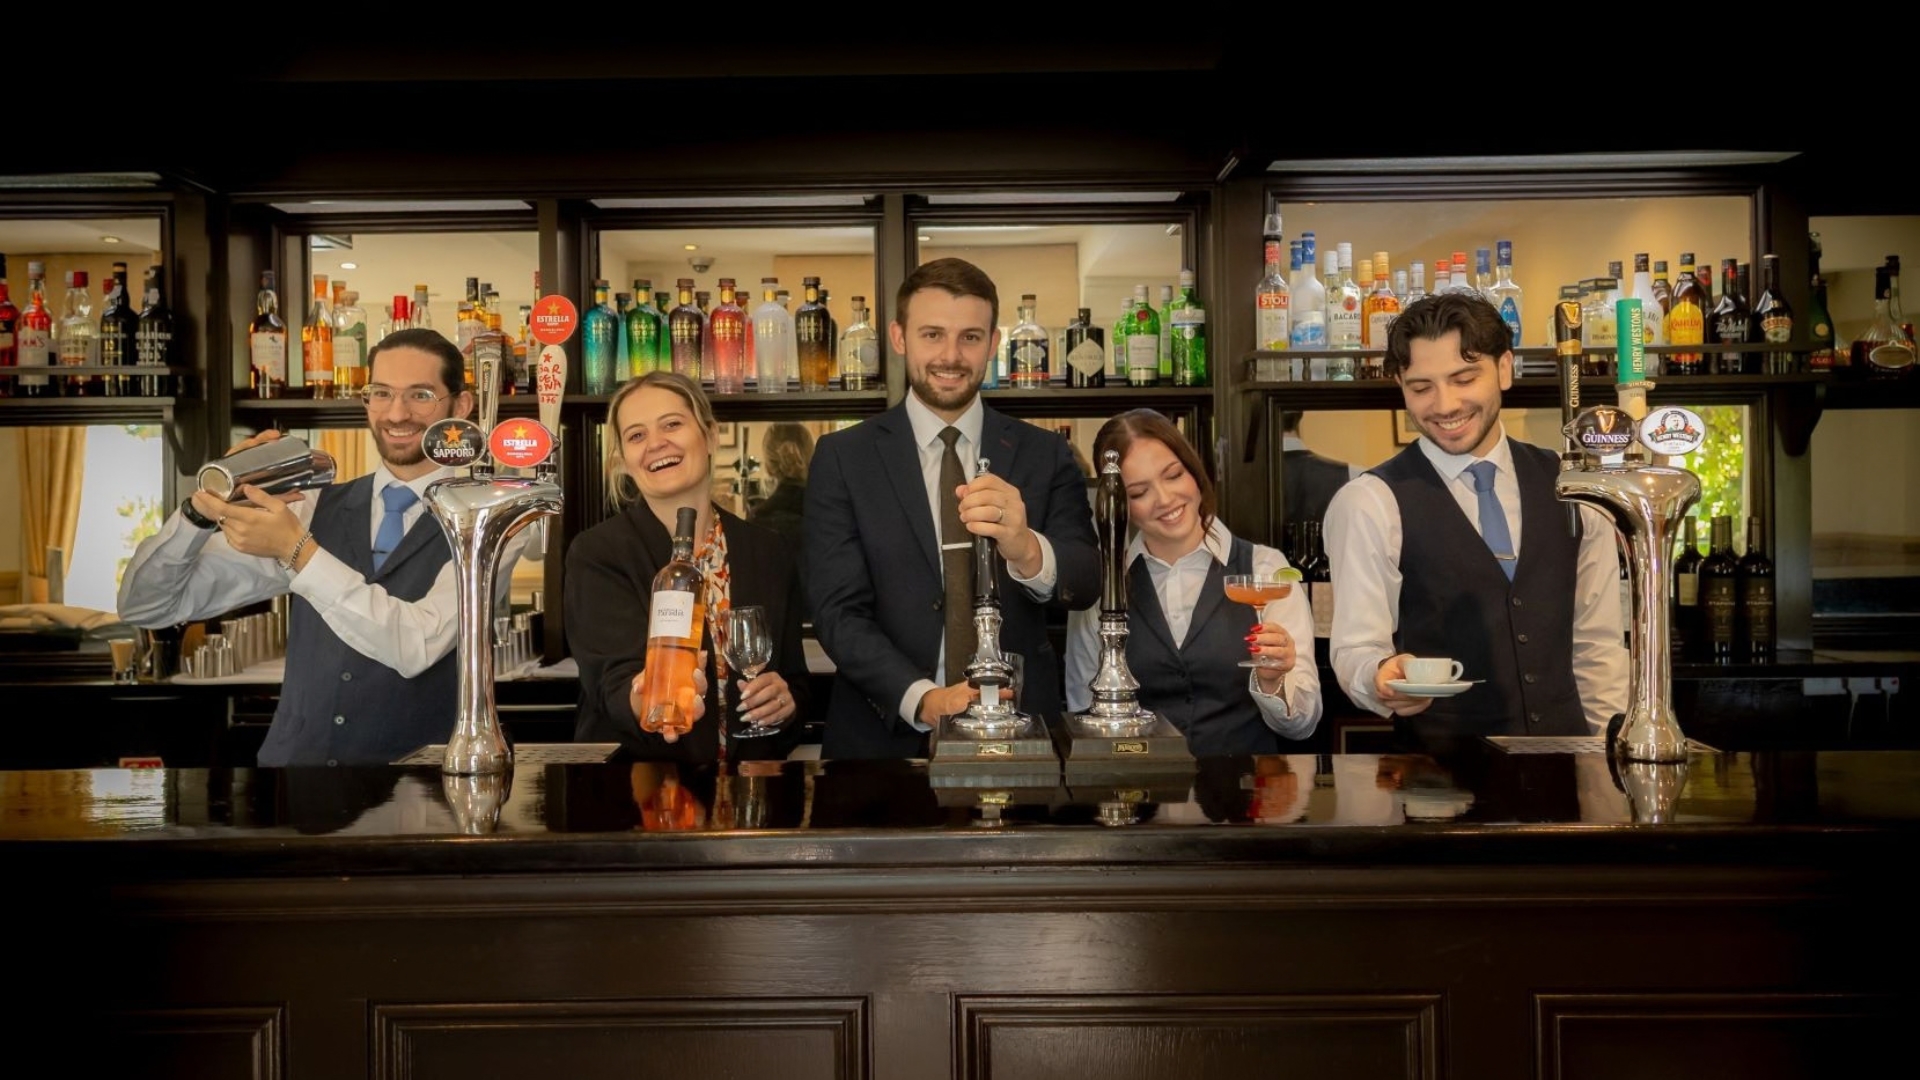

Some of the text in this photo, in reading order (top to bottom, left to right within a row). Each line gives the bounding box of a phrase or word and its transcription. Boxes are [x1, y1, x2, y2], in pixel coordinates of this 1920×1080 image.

[537, 315, 569, 323] ESTRELLA
[1631, 308, 1643, 373] HENRY WESTONS
[1569, 364, 1579, 407] GUINNESS
[1582, 434, 1630, 443] GUINNESS
[434, 448, 475, 458] SAPPORO
